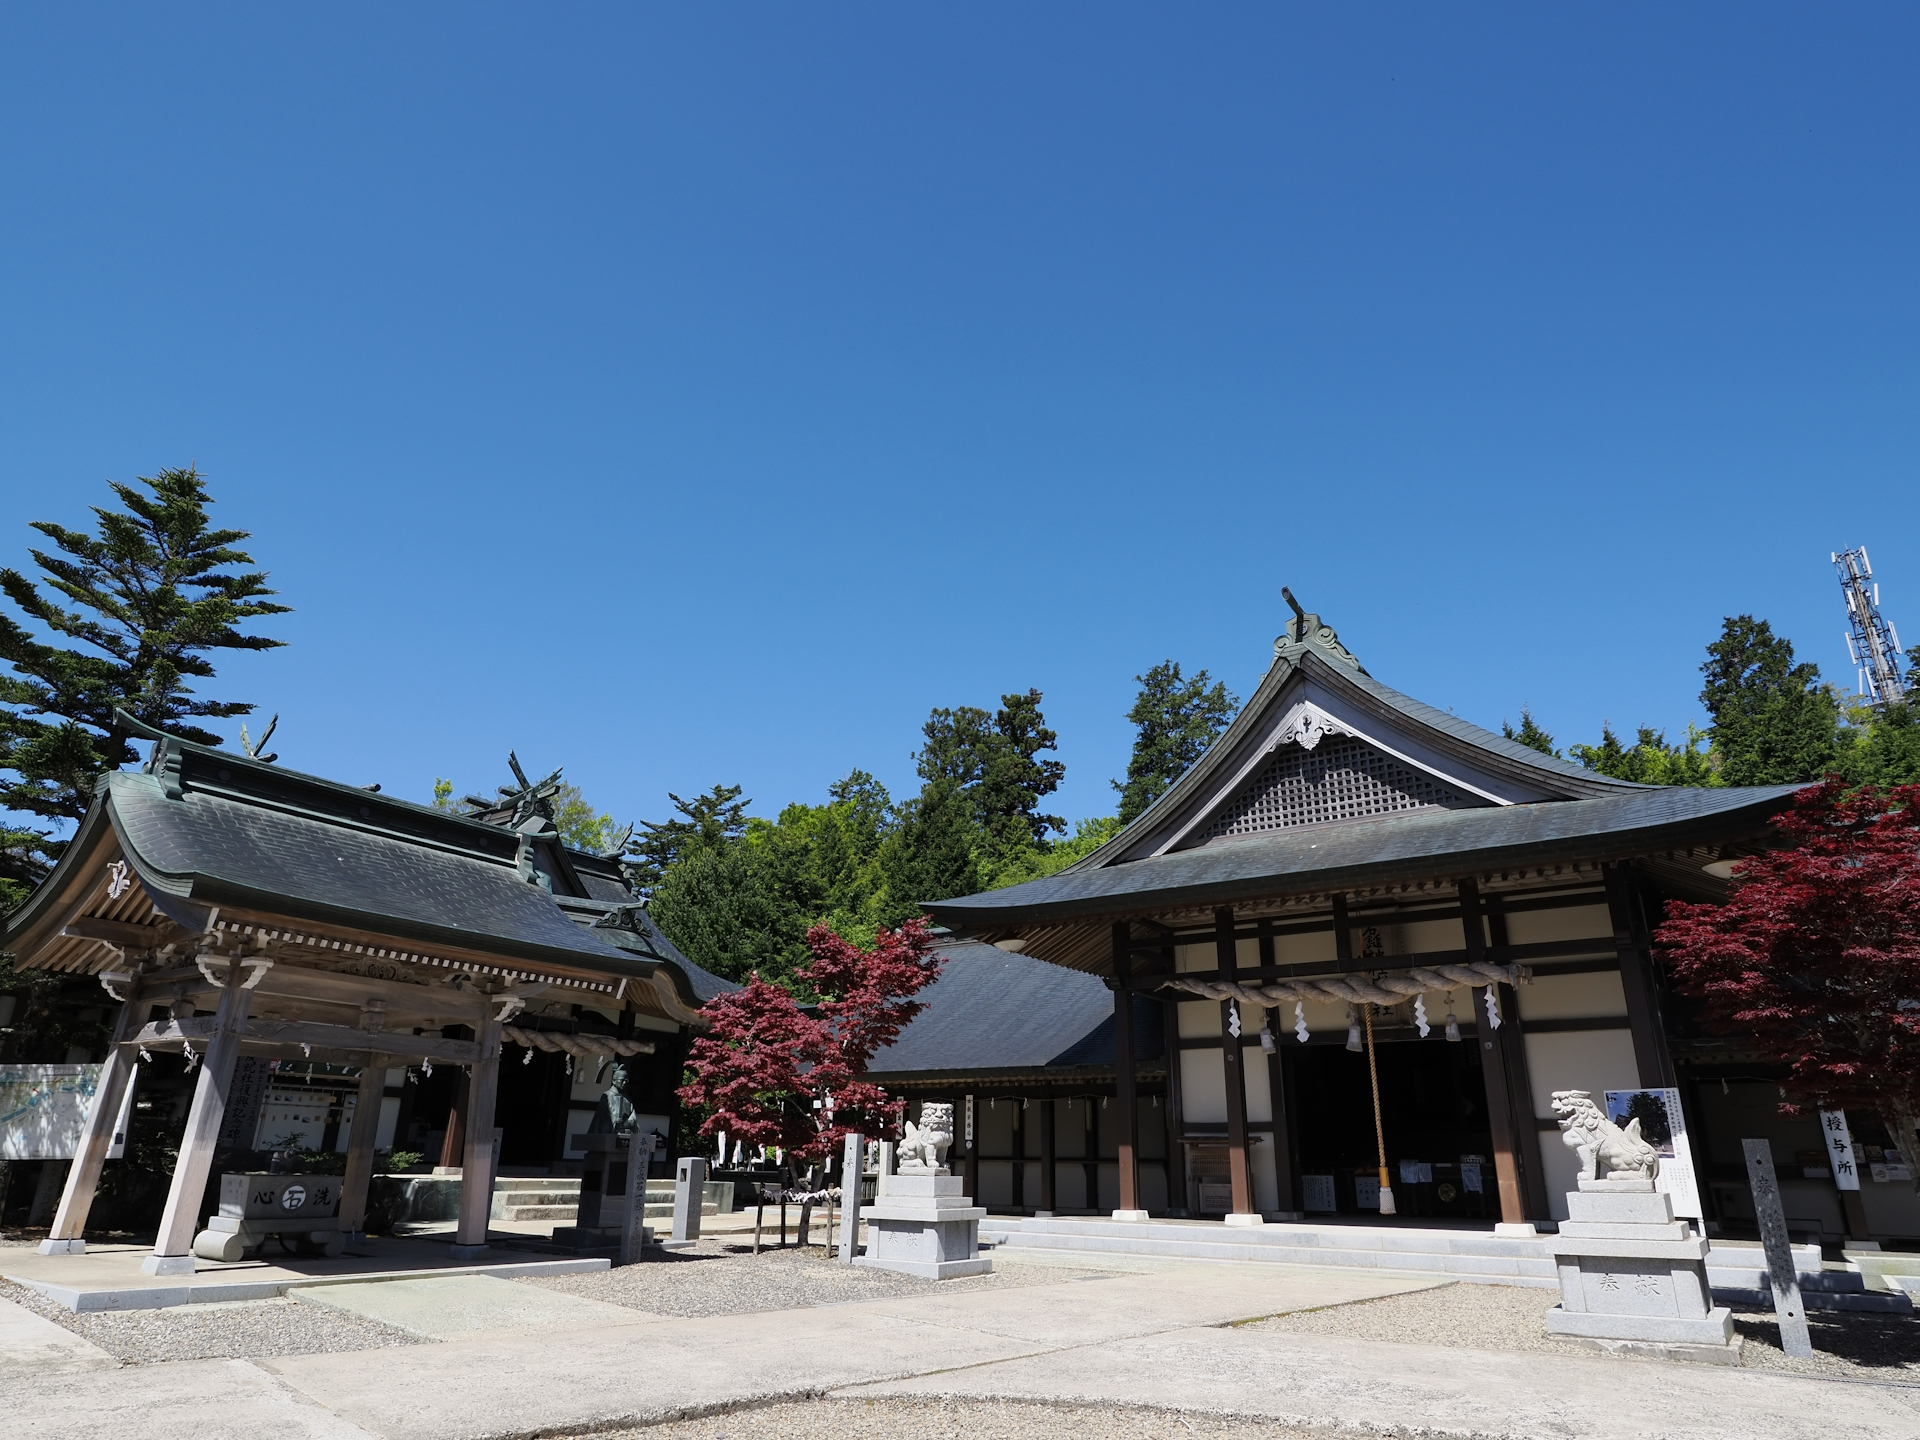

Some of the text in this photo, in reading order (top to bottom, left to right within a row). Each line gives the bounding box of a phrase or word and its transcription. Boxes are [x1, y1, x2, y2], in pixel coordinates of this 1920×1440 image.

[1826, 1116, 1853, 1176] 授与所
[253, 1191, 275, 1205] 心
[282, 1189, 305, 1209] 石
[313, 1187, 331, 1205] 洗
